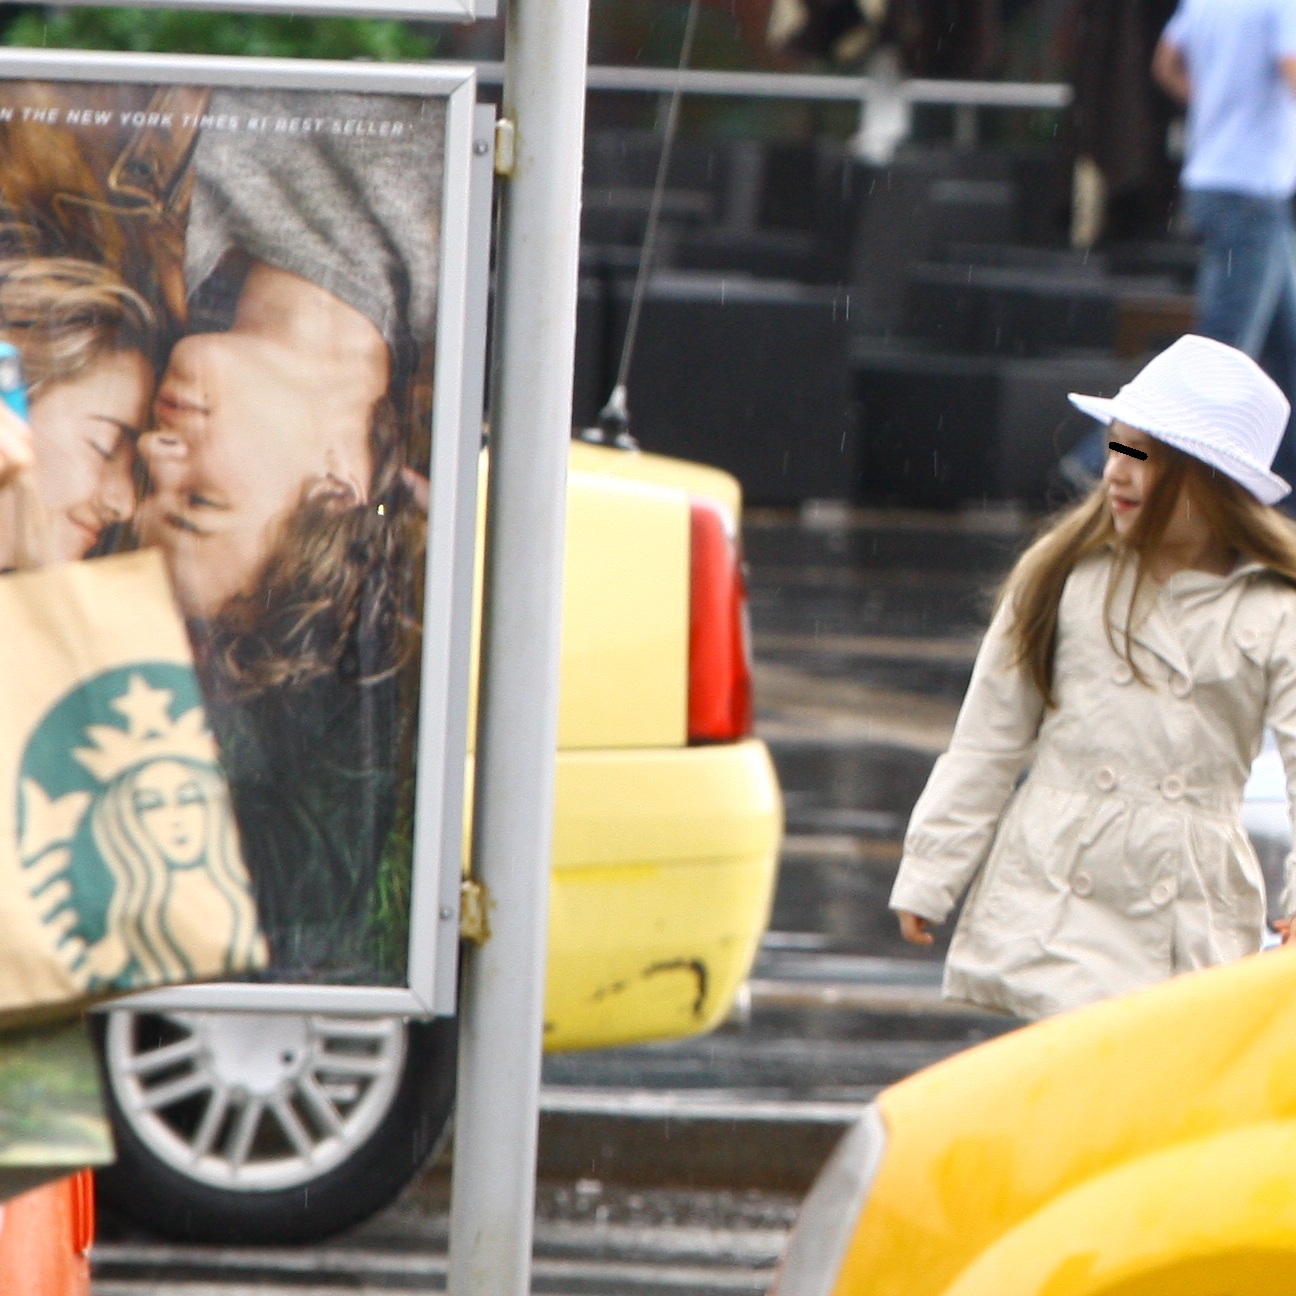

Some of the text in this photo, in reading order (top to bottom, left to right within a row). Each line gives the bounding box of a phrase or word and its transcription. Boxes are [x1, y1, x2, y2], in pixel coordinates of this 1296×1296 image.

[22, 107, 60, 125] THE
[66, 109, 112, 126] NEW
[120, 111, 172, 128] YORK
[182, 113, 238, 132] TIMES
